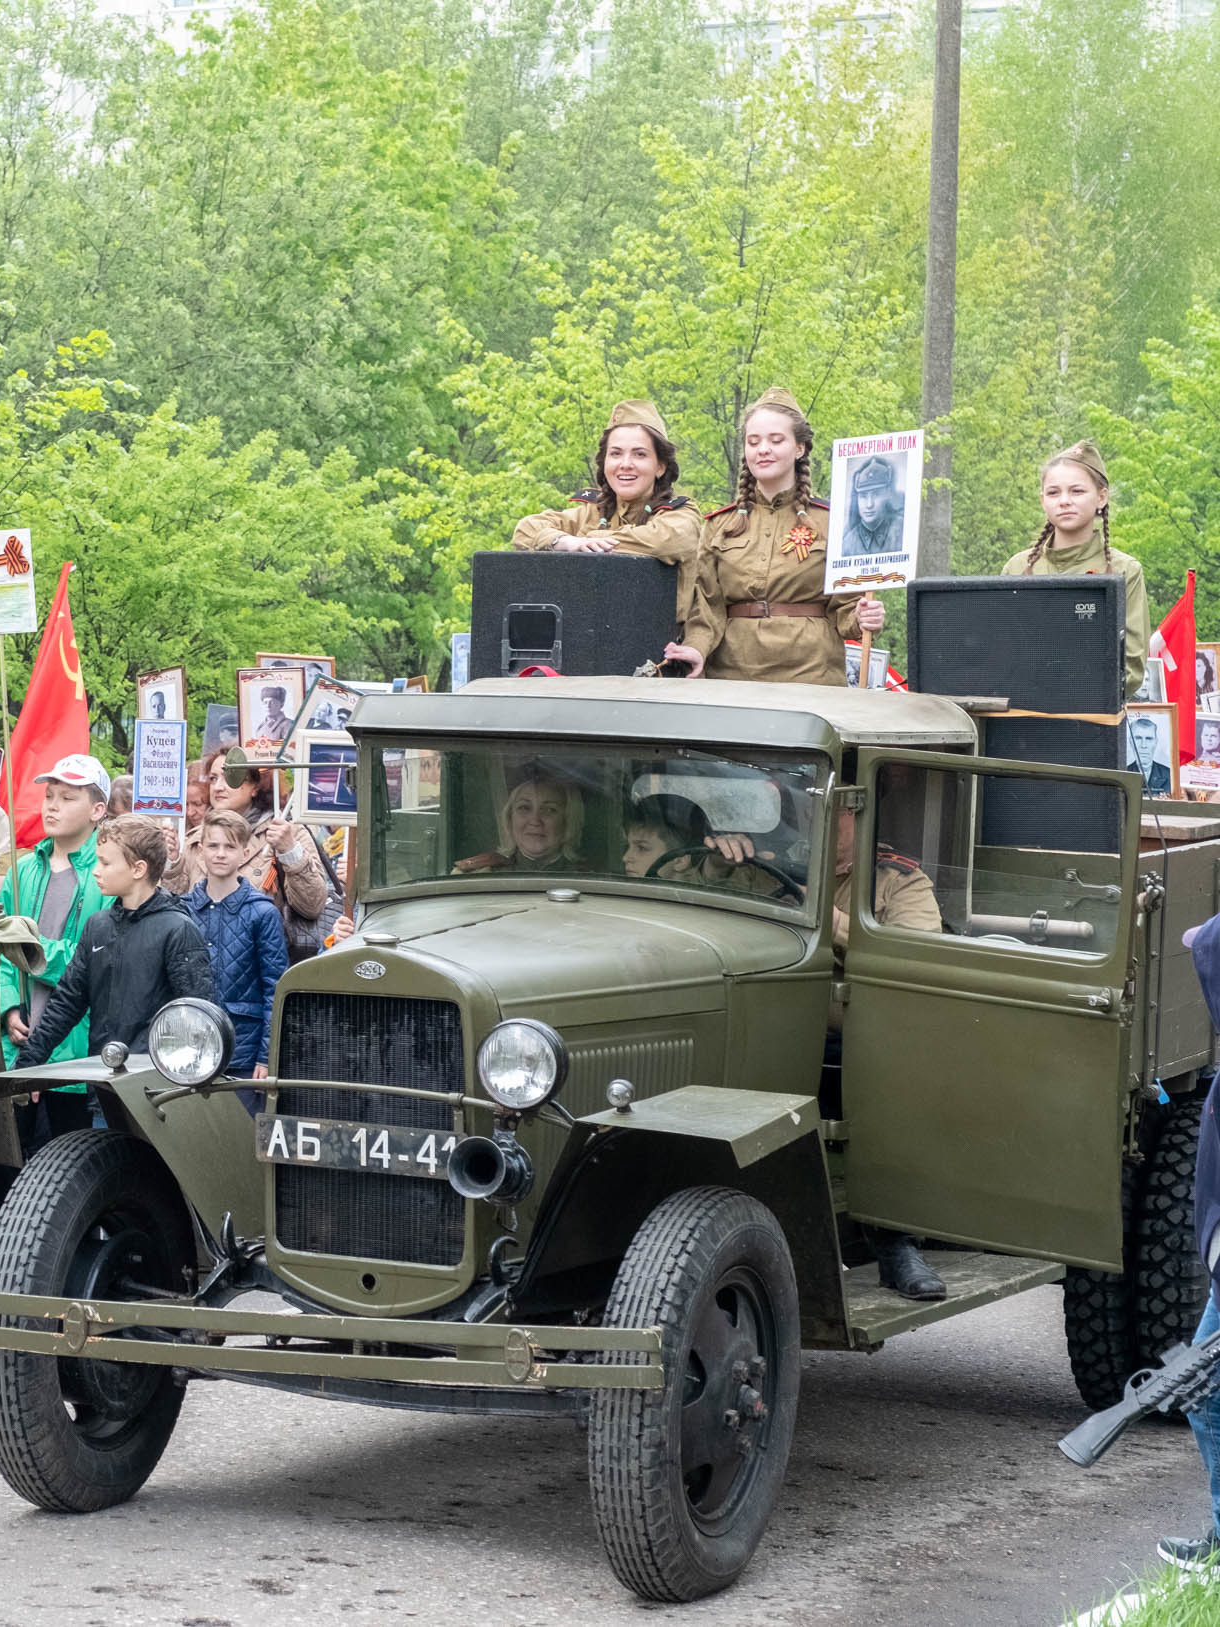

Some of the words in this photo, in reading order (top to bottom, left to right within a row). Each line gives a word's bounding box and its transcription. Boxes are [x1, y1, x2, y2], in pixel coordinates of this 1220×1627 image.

[838, 436, 893, 457] БЕССМЕРТНЫЙ
[897, 435, 917, 450] ПОЛК
[854, 555, 873, 567] КУЗЬМА
[146, 735, 176, 748] Куцев
[266, 1119, 321, 1162] АБ
